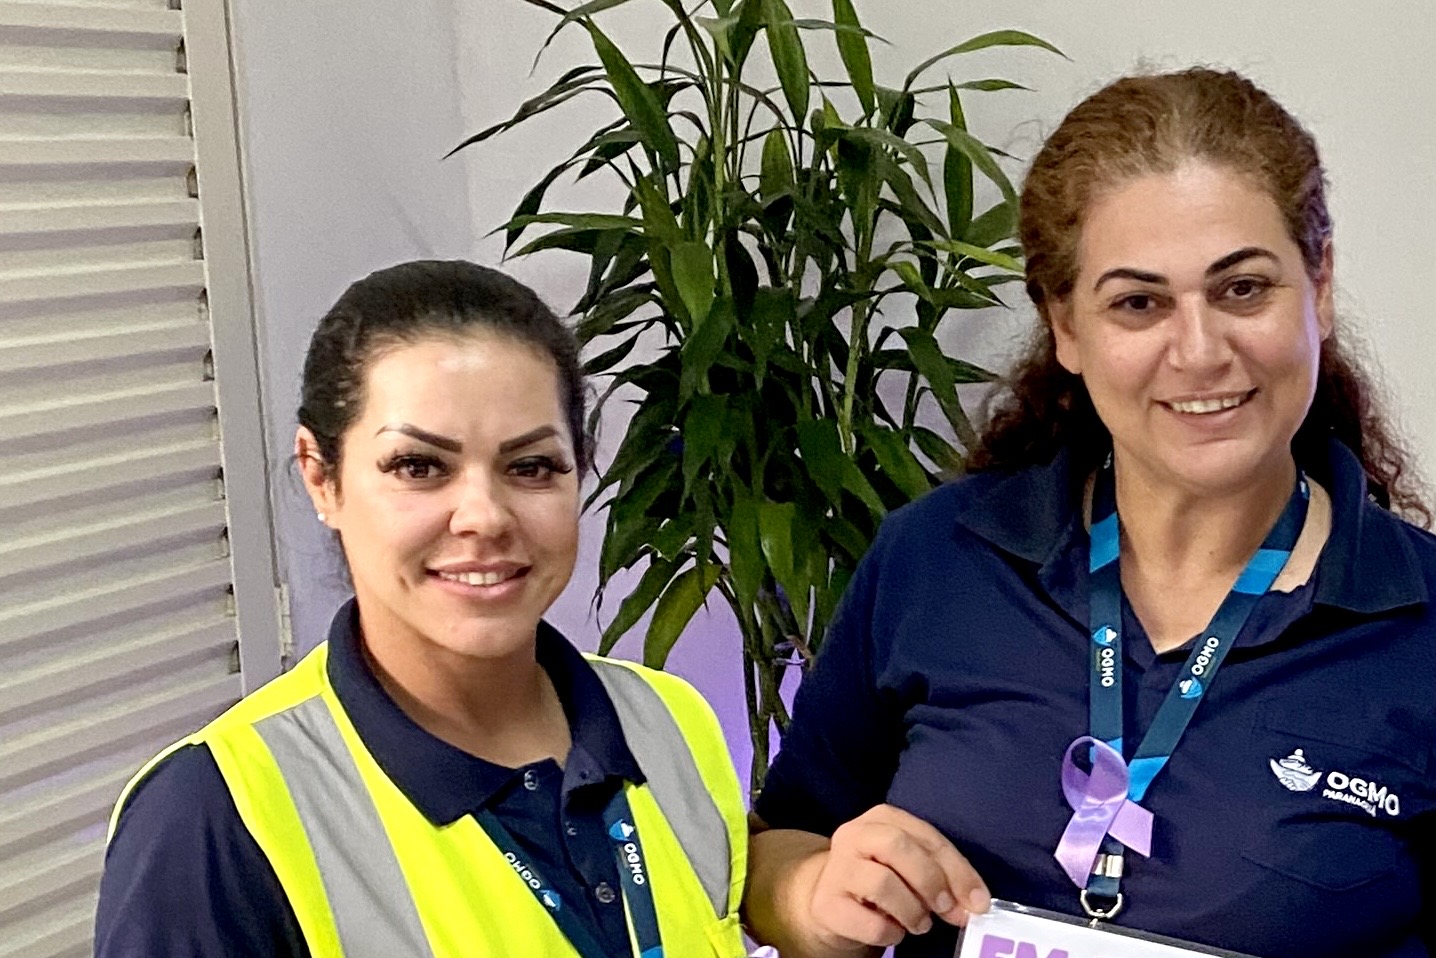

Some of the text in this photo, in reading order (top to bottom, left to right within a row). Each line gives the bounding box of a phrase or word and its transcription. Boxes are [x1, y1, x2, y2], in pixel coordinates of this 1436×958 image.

[1101, 648, 1115, 687] OGMO
[1191, 636, 1219, 676] OGMO
[1326, 771, 1400, 816] OGMO
[624, 843, 645, 885] OGMO
